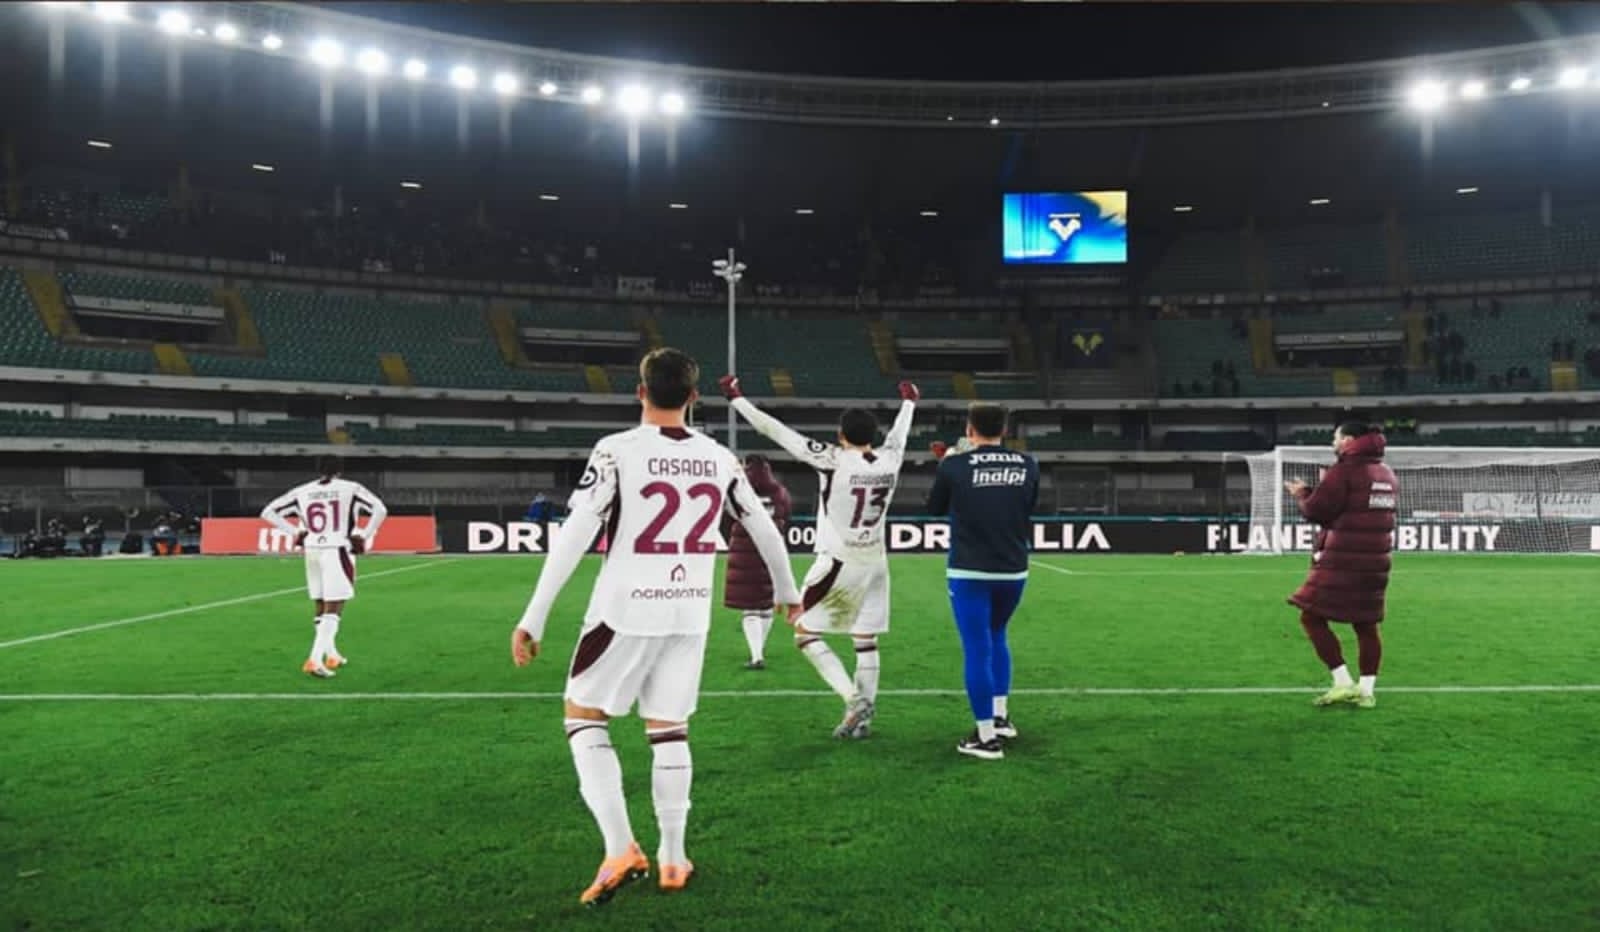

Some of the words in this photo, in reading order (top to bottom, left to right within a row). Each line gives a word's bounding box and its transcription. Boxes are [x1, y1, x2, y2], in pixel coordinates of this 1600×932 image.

[648, 458, 717, 477] CASADEI
[973, 467, 1027, 485] inalpi
[306, 500, 340, 534] 61
[633, 481, 722, 554] 22
[850, 488, 889, 528] 13
